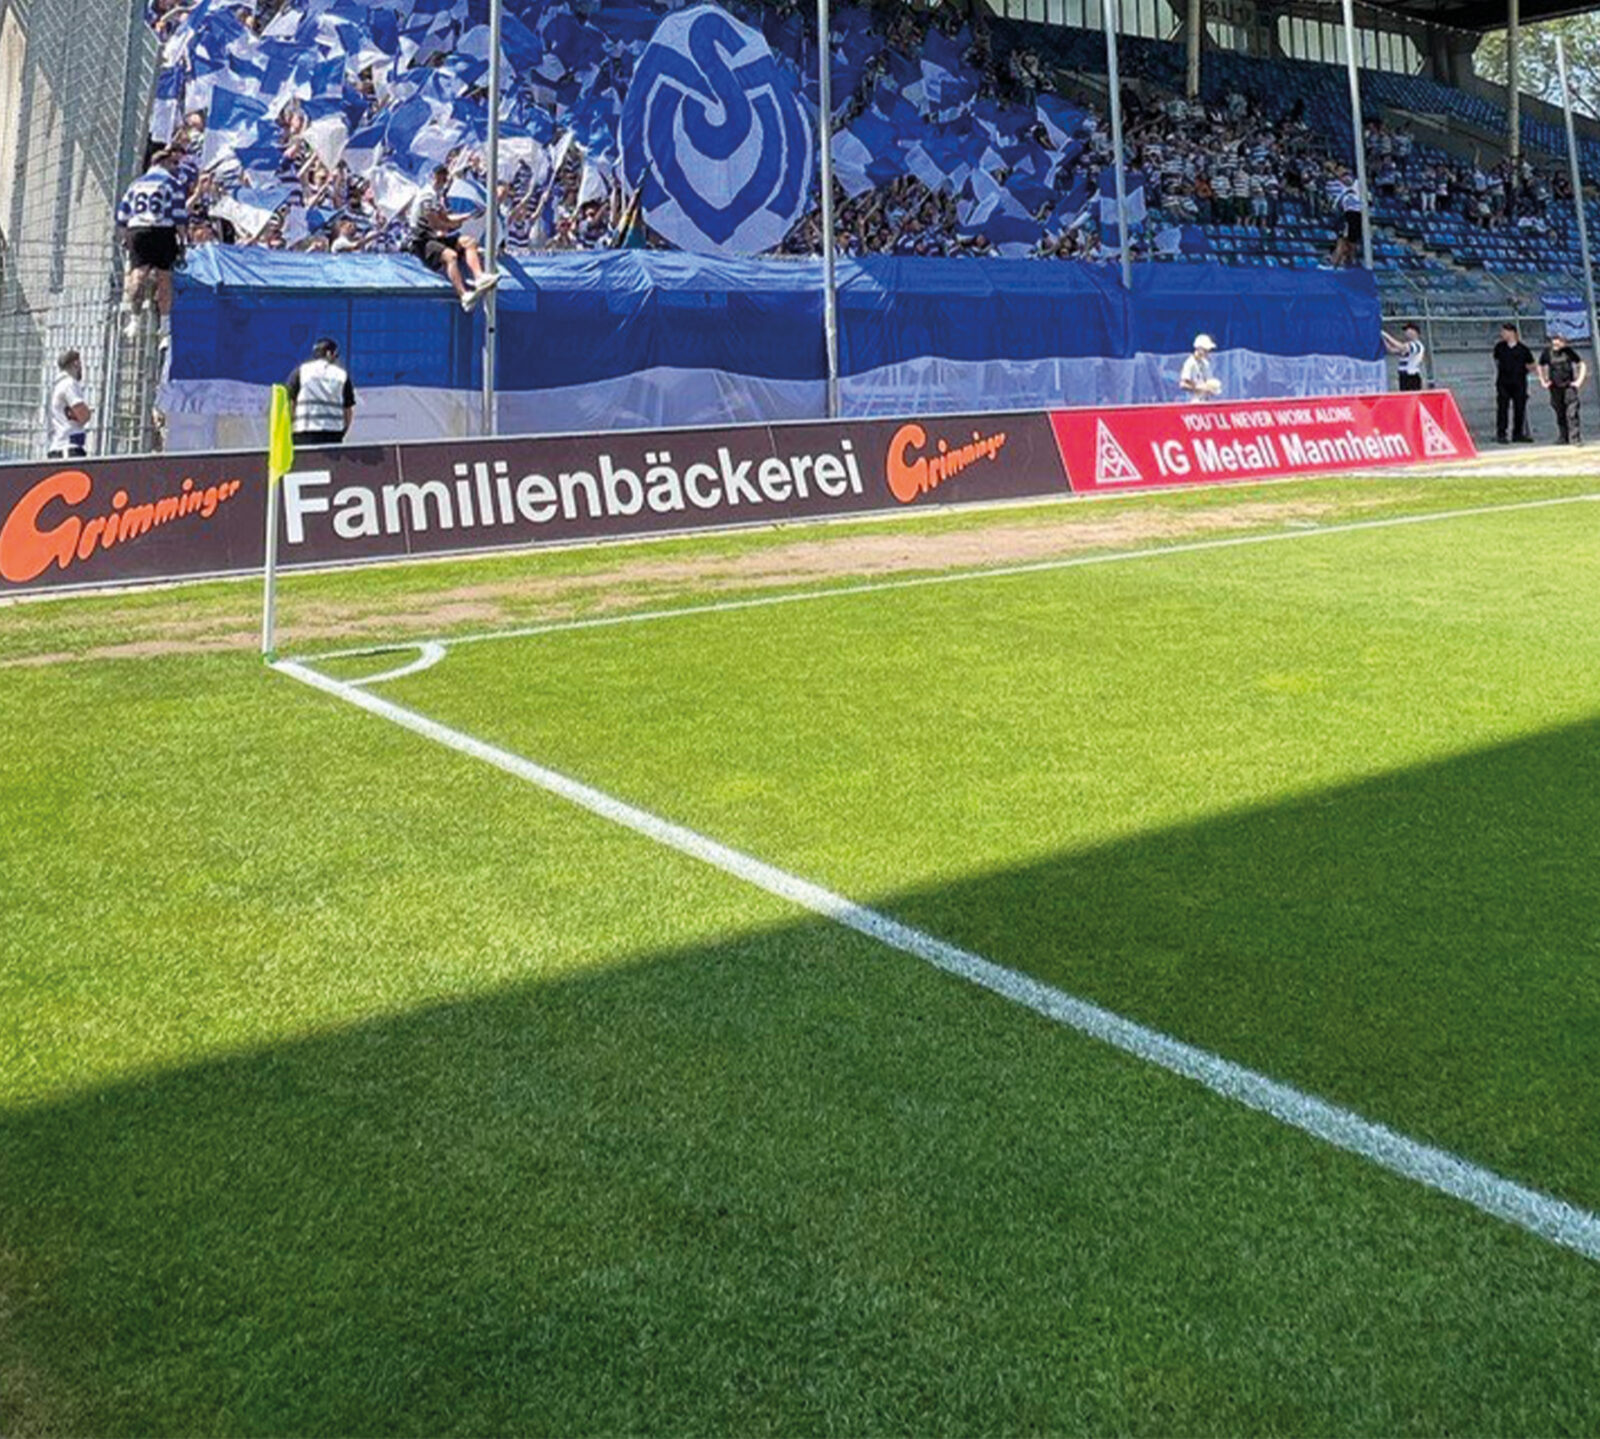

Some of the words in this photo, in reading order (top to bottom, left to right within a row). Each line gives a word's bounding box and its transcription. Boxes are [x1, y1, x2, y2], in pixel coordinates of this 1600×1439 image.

[135, 191, 163, 215] 66
[1230, 410, 1274, 428] NEVER
[1273, 408, 1313, 426] WORK
[1315, 406, 1355, 422] ALONE
[886, 423, 1006, 503] Grimminger
[1151, 439, 1192, 476] IG
[1191, 435, 1280, 473] Metall
[1279, 428, 1411, 467] Mannheim
[281, 438, 864, 544] Familienbäckerei
[0, 470, 240, 582] Grimminger
